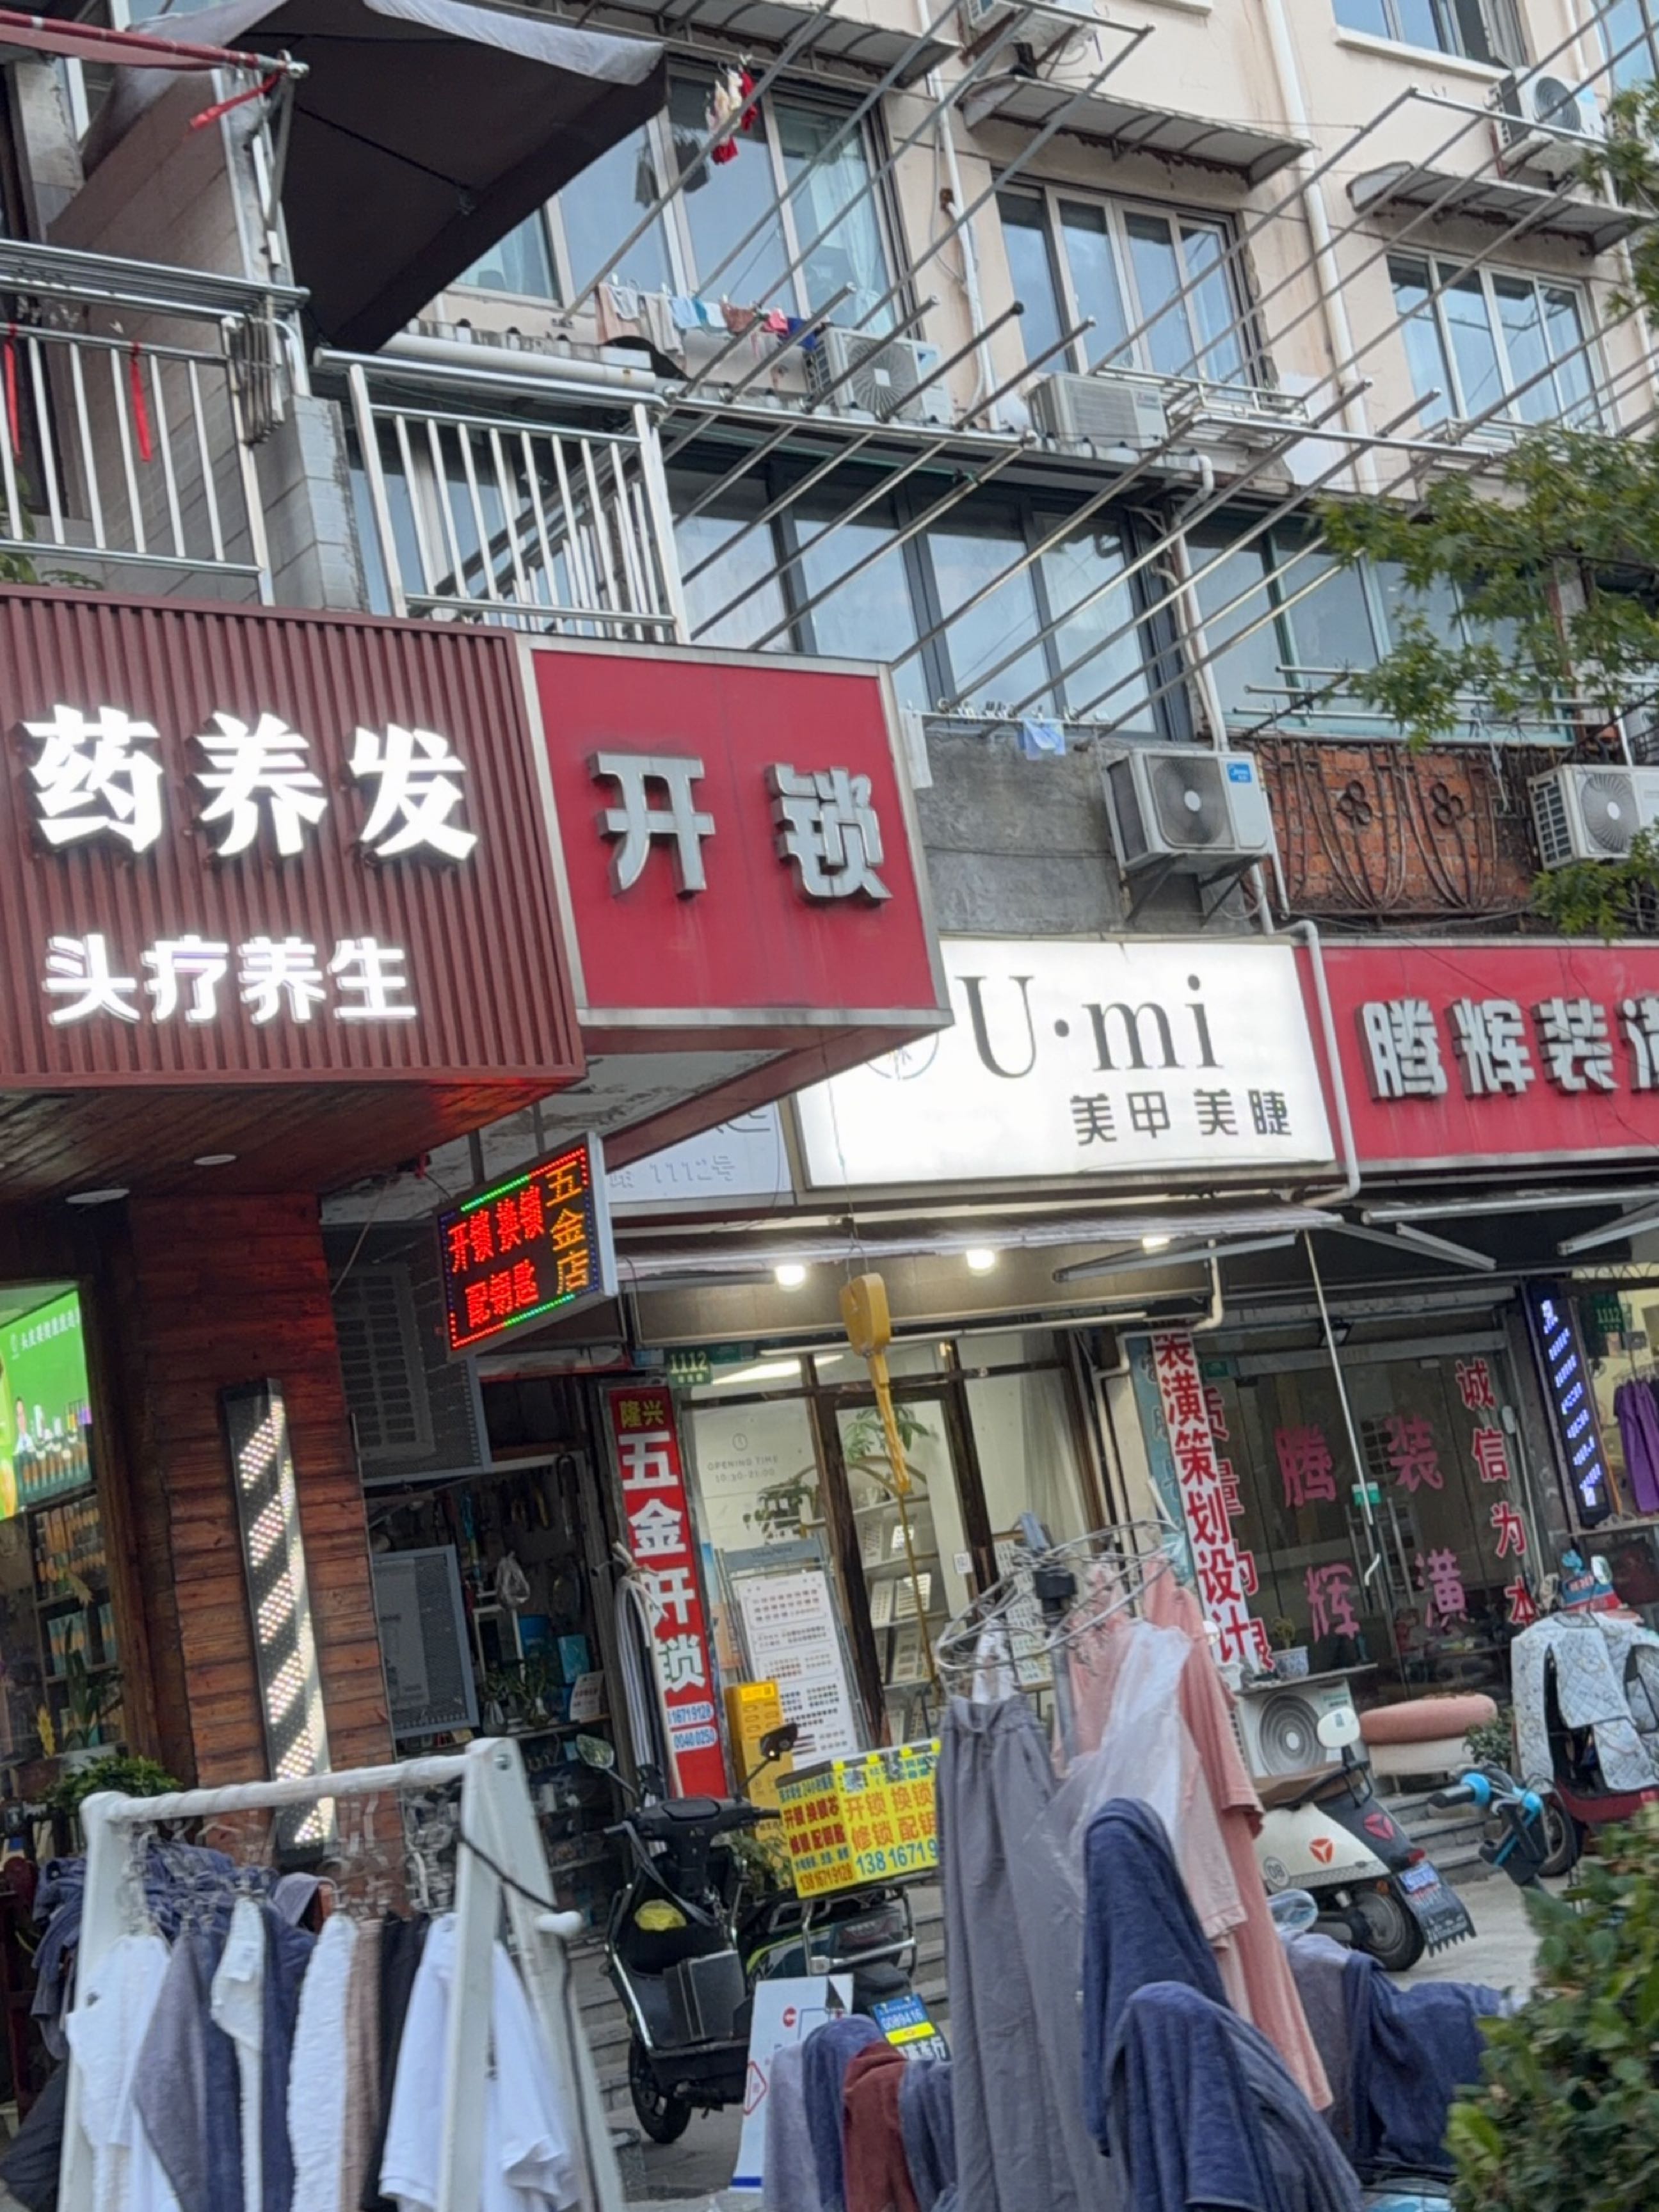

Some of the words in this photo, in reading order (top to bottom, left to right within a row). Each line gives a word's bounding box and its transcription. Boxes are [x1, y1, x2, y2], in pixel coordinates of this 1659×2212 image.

[20, 704, 477, 861] 药养发
[588, 751, 893, 902] 开锁
[42, 933, 417, 1024] 头疗养生
[1070, 1089, 1293, 1146] 美甲美睫
[545, 1161, 589, 1294] 五金店
[669, 1350, 708, 1374] 1112
[618, 1430, 705, 1693] 五金开锁
[1455, 1357, 1540, 1626] 诚信为本
